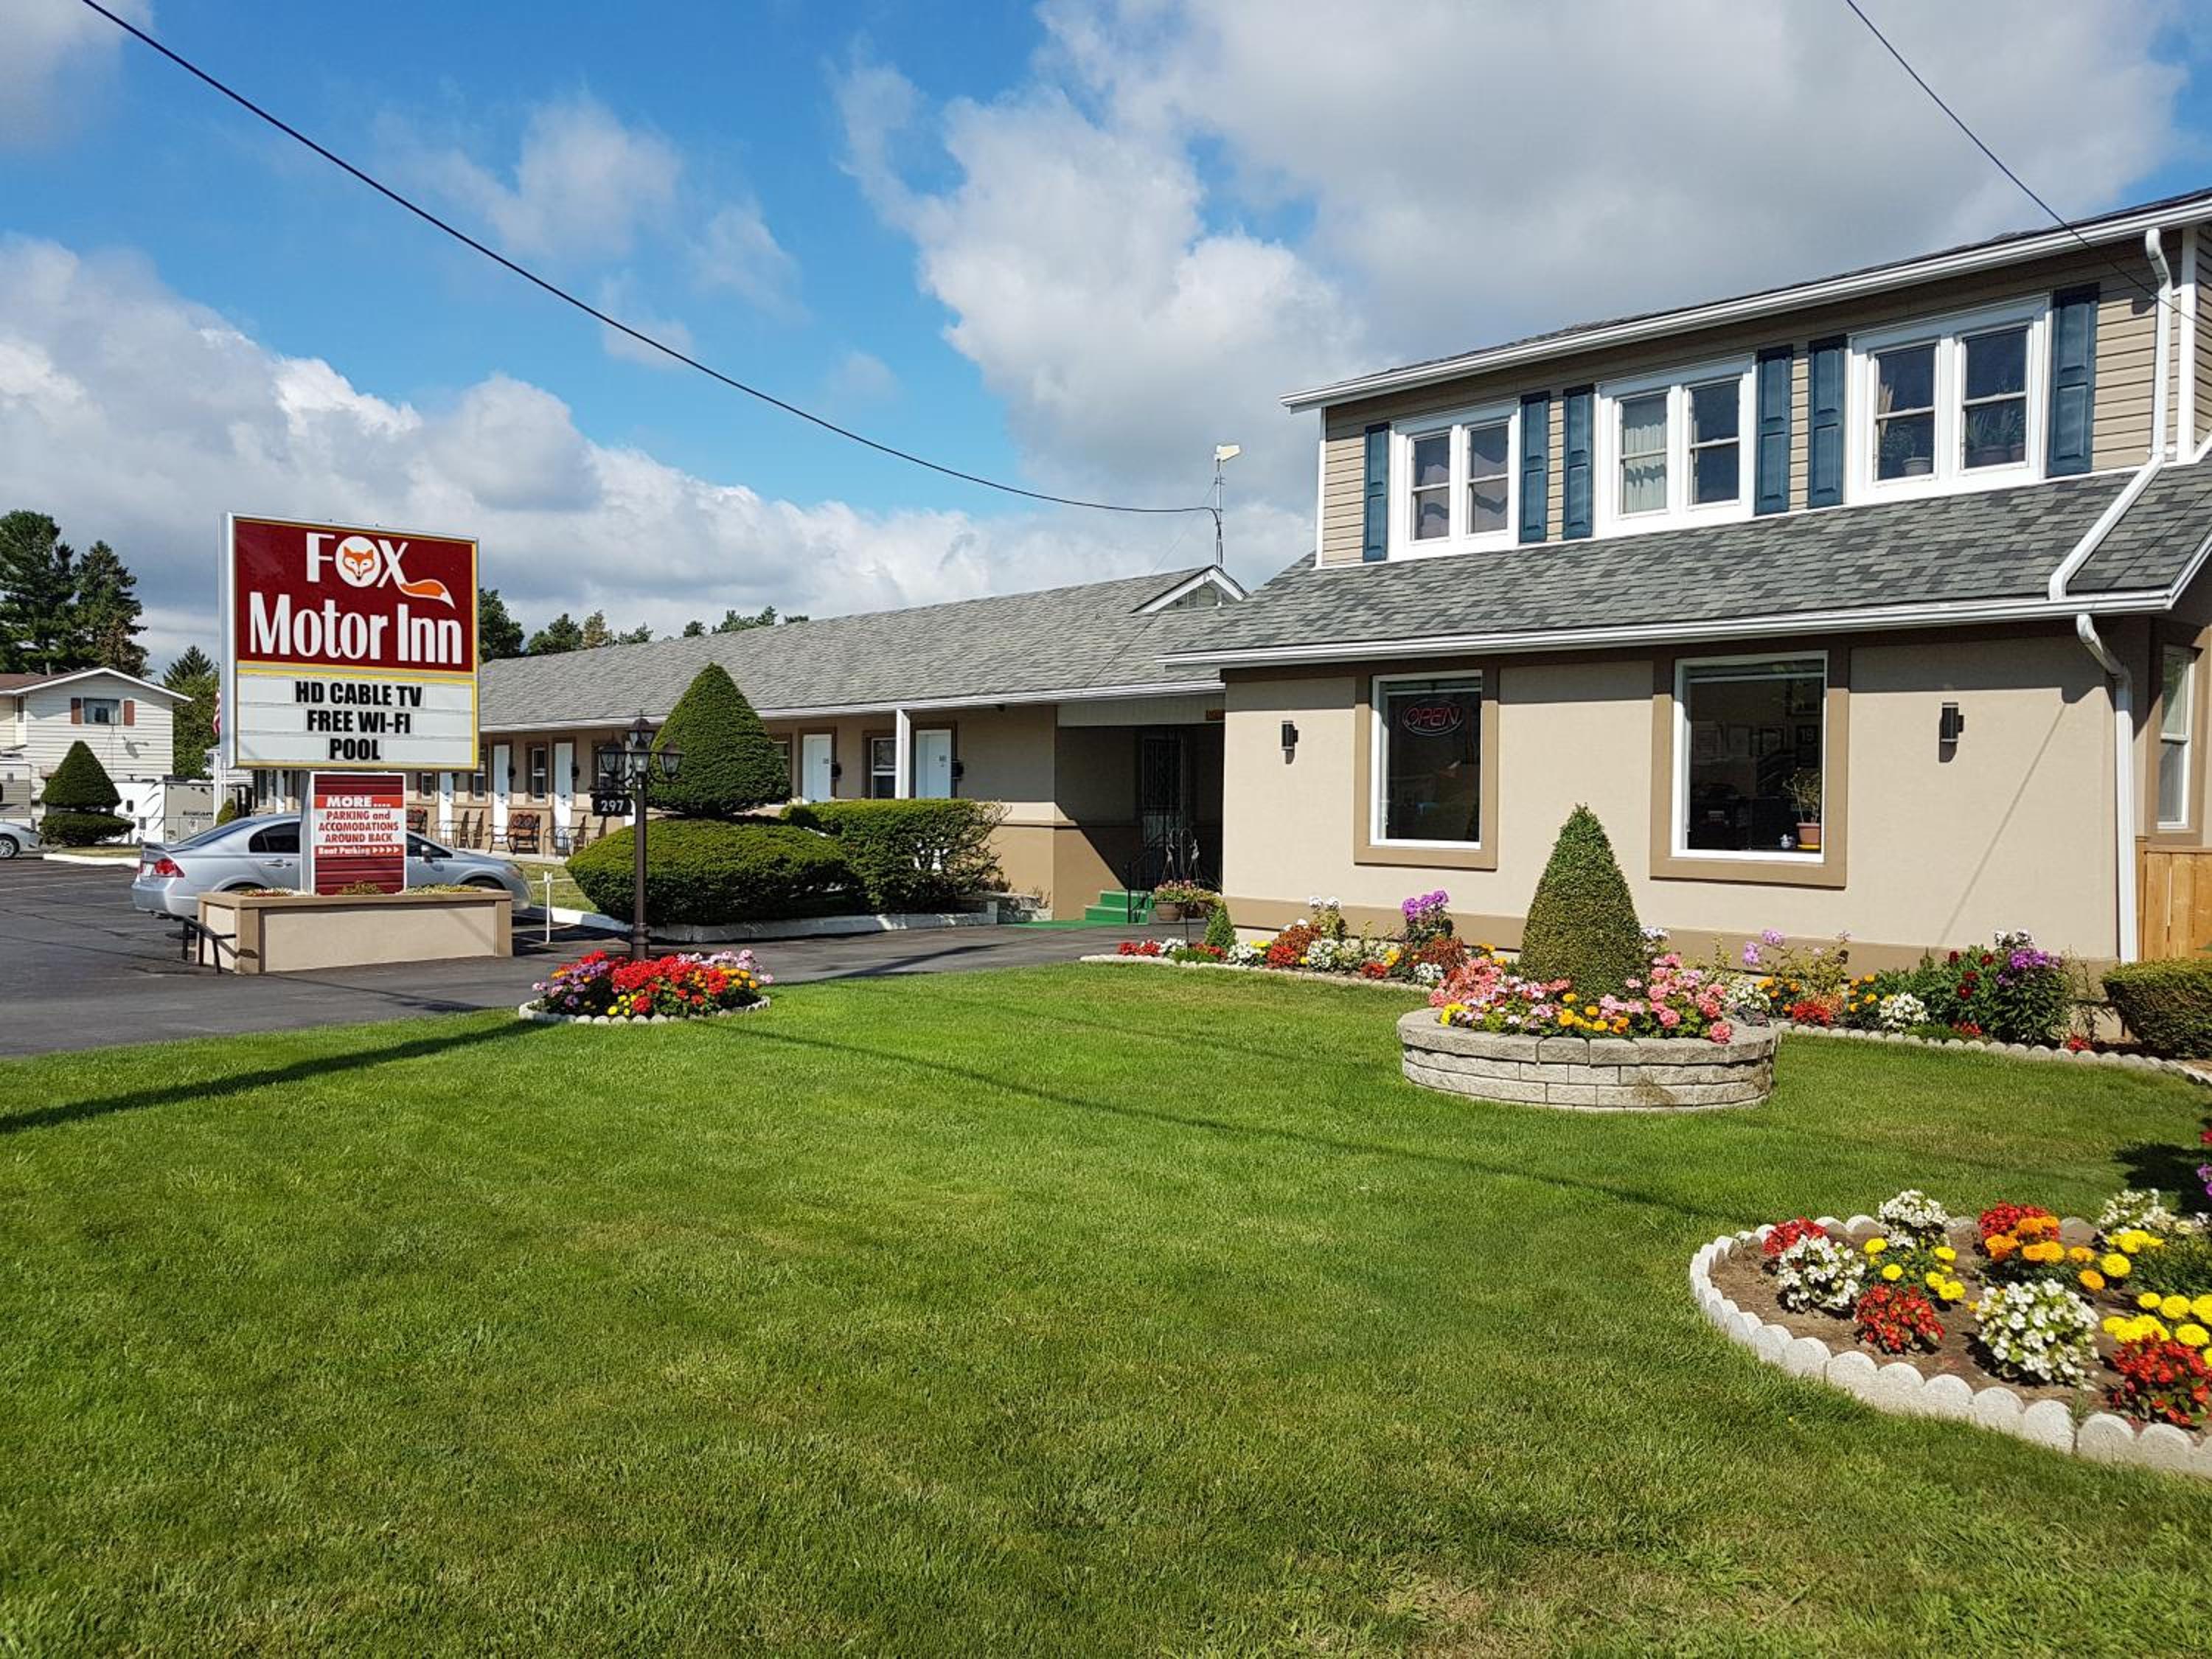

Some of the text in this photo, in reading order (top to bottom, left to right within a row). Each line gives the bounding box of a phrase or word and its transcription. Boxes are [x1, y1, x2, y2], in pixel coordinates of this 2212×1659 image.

[249, 592, 462, 664] Motor Inn
[295, 681, 422, 706] HD CABLE TV
[307, 709, 411, 734] FREE WI-FI
[1405, 707, 1461, 726] OPEN
[329, 738, 380, 760] POOL
[327, 810, 390, 821] PARKING and
[601, 800, 625, 812] 297
[319, 822, 399, 832] ACCOMODATIONS
[325, 832, 393, 844] AROUND BACK
